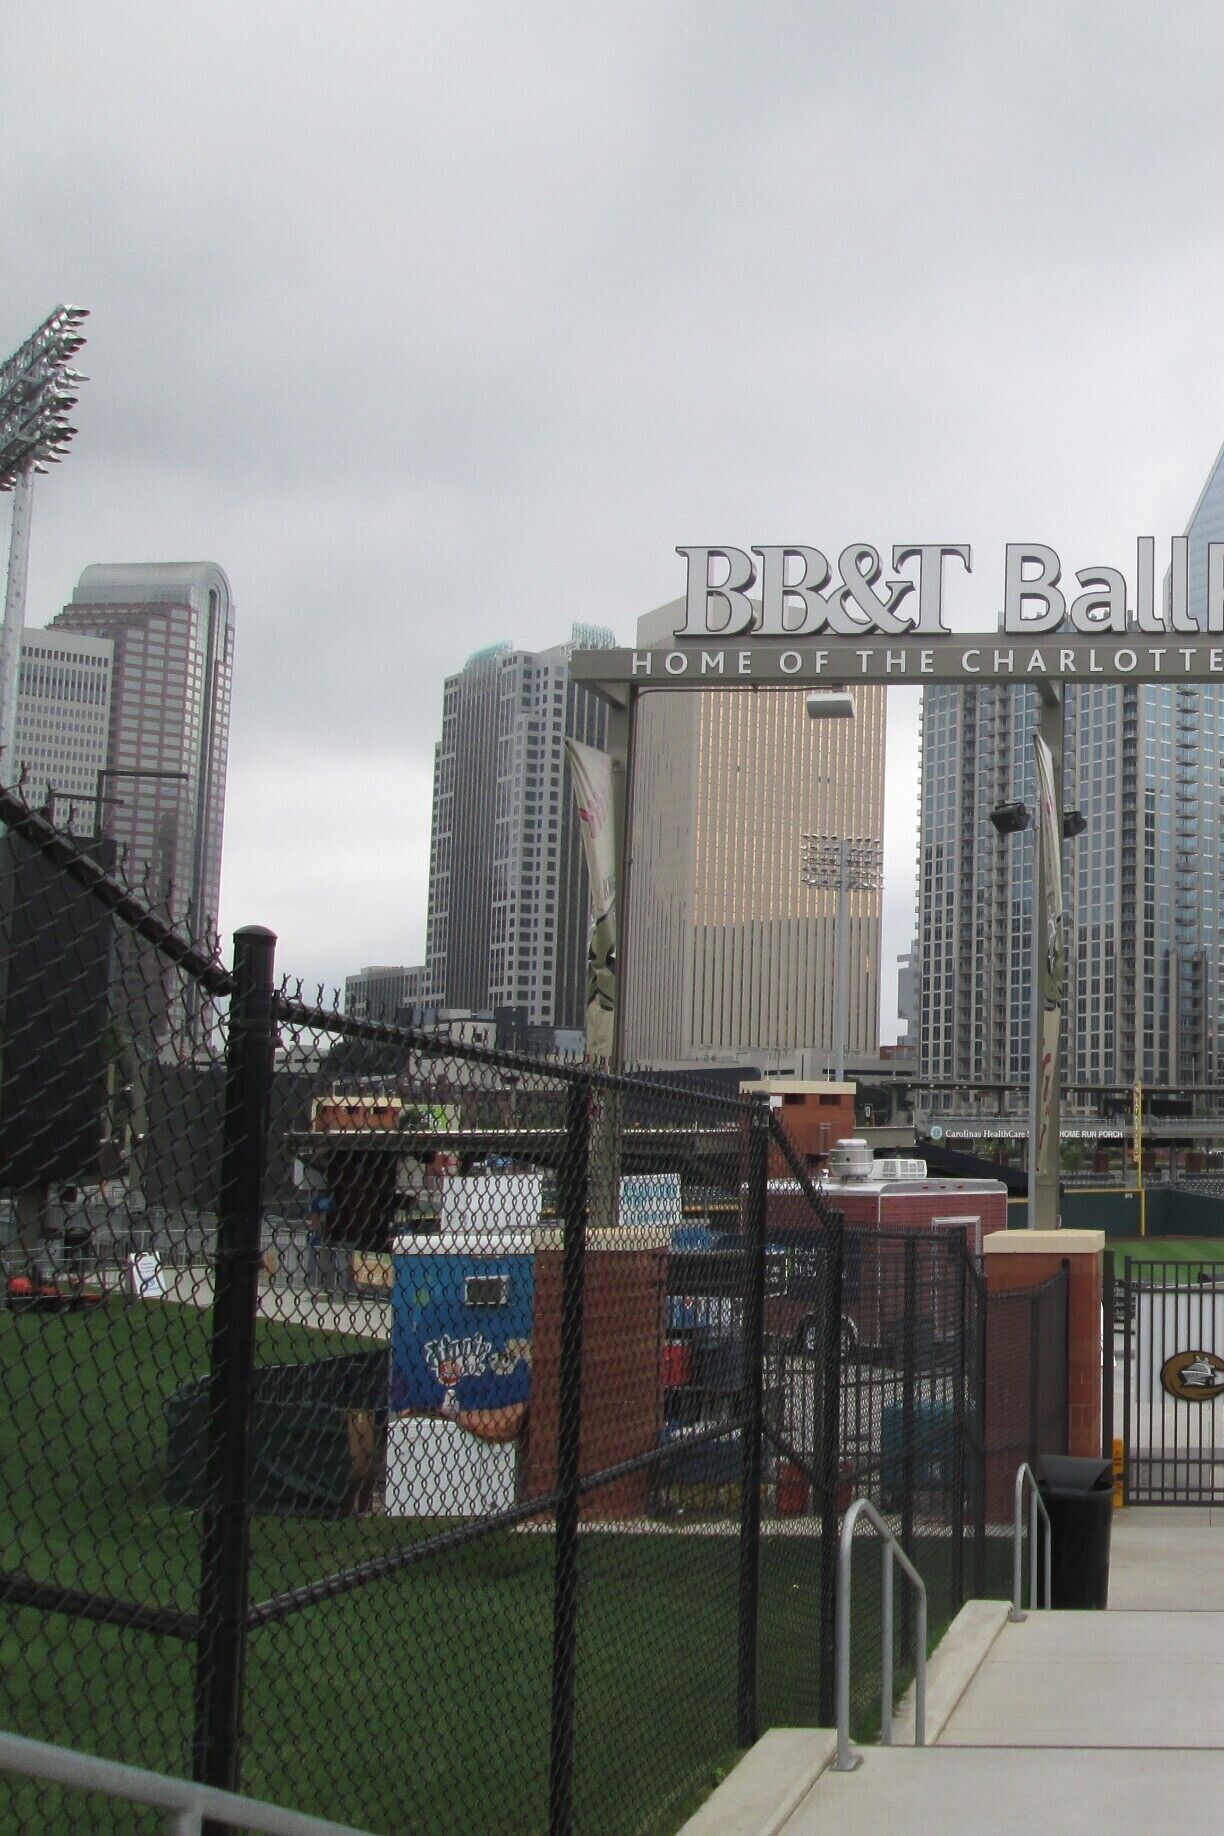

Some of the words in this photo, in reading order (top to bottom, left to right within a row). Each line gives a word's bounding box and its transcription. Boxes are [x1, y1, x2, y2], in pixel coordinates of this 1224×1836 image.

[673, 543, 972, 640] BB&T
[631, 651, 752, 675] HOME
[779, 651, 829, 675] OF
[856, 650, 934, 674] THE
[961, 649, 1224, 674] CHARLOTTE
[945, 1130, 982, 1138] Carolinas
[983, 1129, 1025, 1138] HealthCare
[1059, 1130, 1080, 1138] HOME
[1082, 1130, 1097, 1138] RUN
[1098, 1130, 1123, 1138] PORCH
